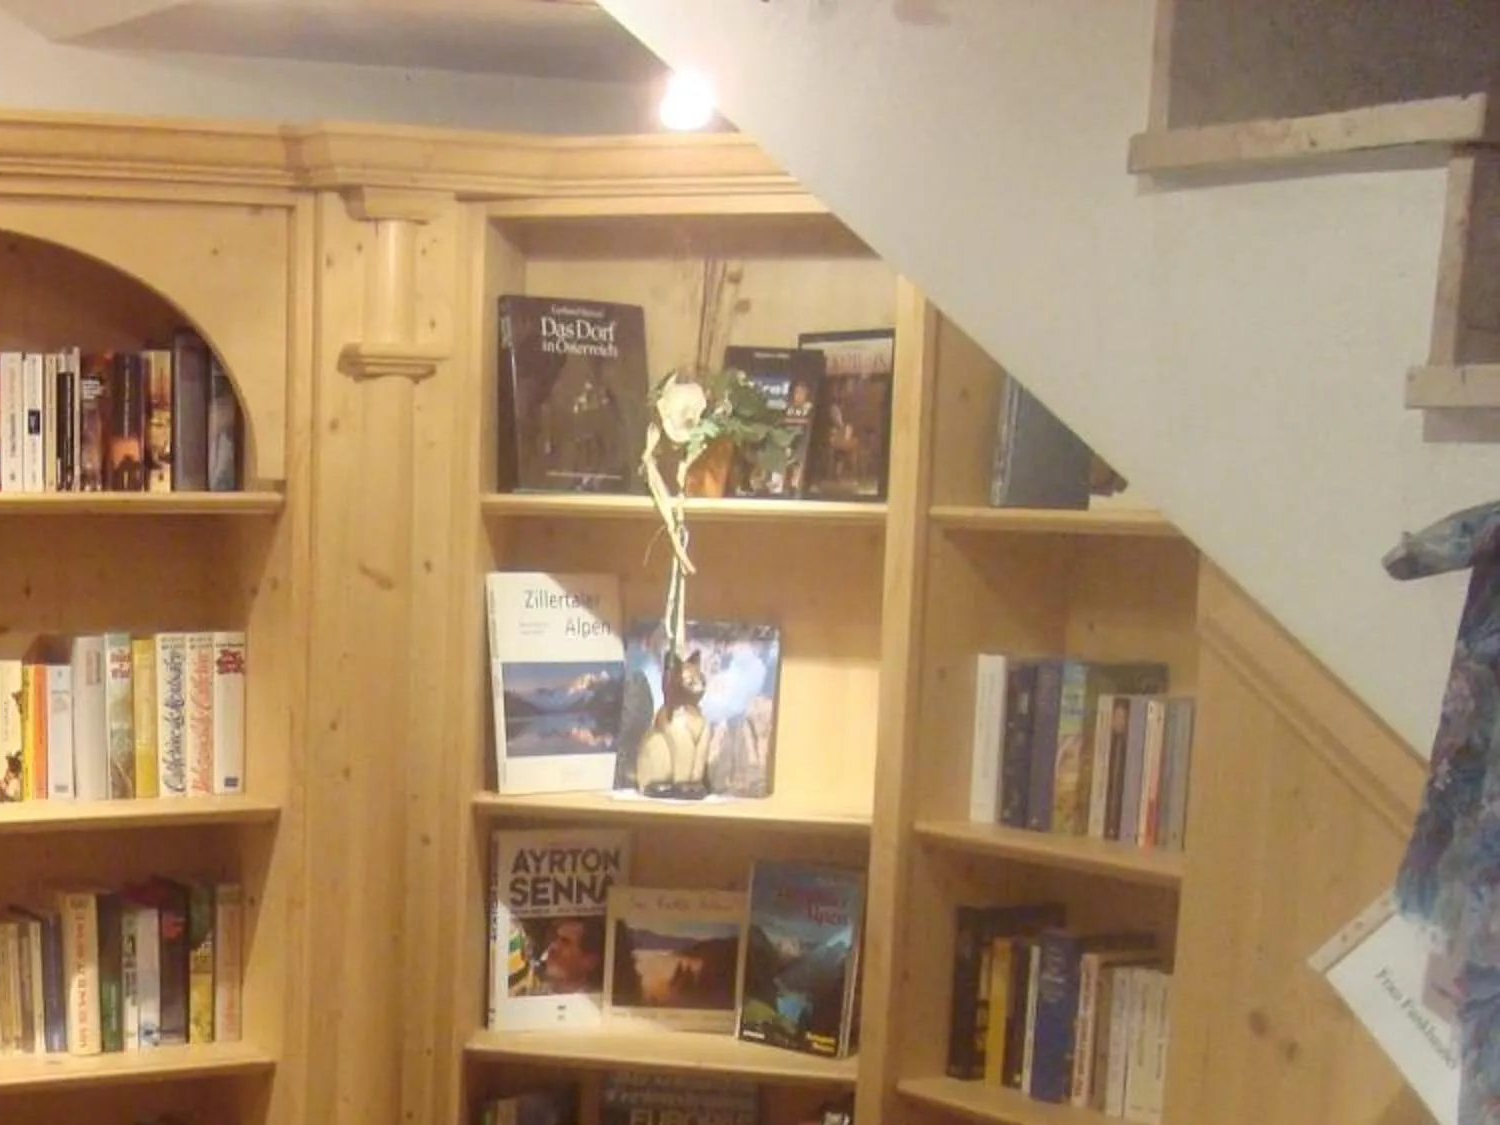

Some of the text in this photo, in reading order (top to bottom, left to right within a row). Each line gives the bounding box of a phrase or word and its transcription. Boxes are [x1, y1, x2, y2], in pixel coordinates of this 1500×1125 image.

[541, 316, 617, 341] Das Dorf
[542, 339, 555, 354] in
[524, 588, 601, 610] Zillertaler
[565, 615, 611, 640] Alpen
[511, 847, 621, 874] AYRTON
[509, 875, 610, 906] SENNA
